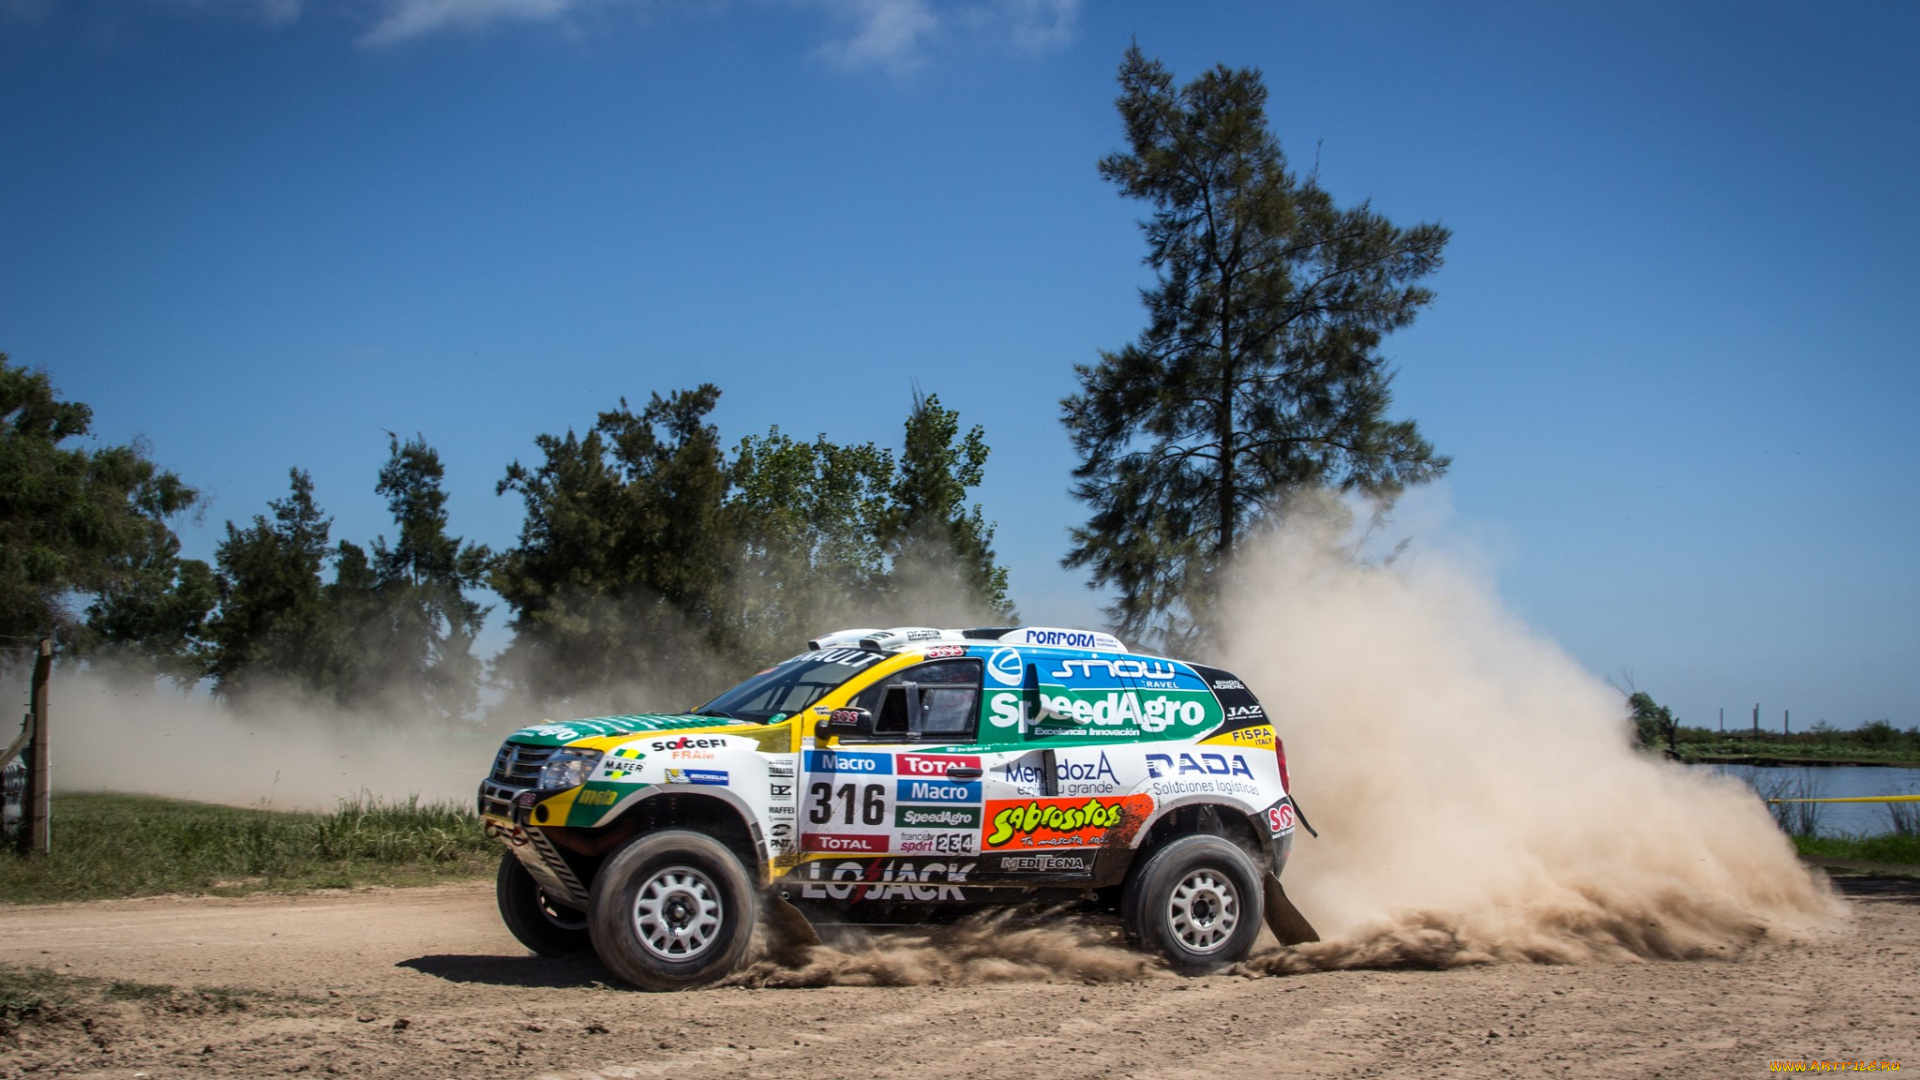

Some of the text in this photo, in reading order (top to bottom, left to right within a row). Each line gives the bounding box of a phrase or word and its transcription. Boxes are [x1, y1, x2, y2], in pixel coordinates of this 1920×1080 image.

[1026, 631, 1095, 647] PORPORA
[989, 692, 1205, 734] SpeedAgro
[1227, 705, 1262, 717] JAZ
[1089, 727, 1140, 736] Innovación
[1232, 728, 1272, 742] FISPA
[1255, 738, 1273, 746] ITALY
[604, 759, 644, 773] MAFER
[822, 755, 876, 771] Macro
[1145, 753, 1255, 780] DADA
[911, 783, 968, 799] Macro
[1068, 781, 1113, 796] grande
[1153, 781, 1214, 795] Soluciones
[809, 782, 885, 826] 316
[904, 811, 972, 825] SpeedAgro
[819, 837, 872, 850] TOTAL
[900, 841, 934, 853] sport
